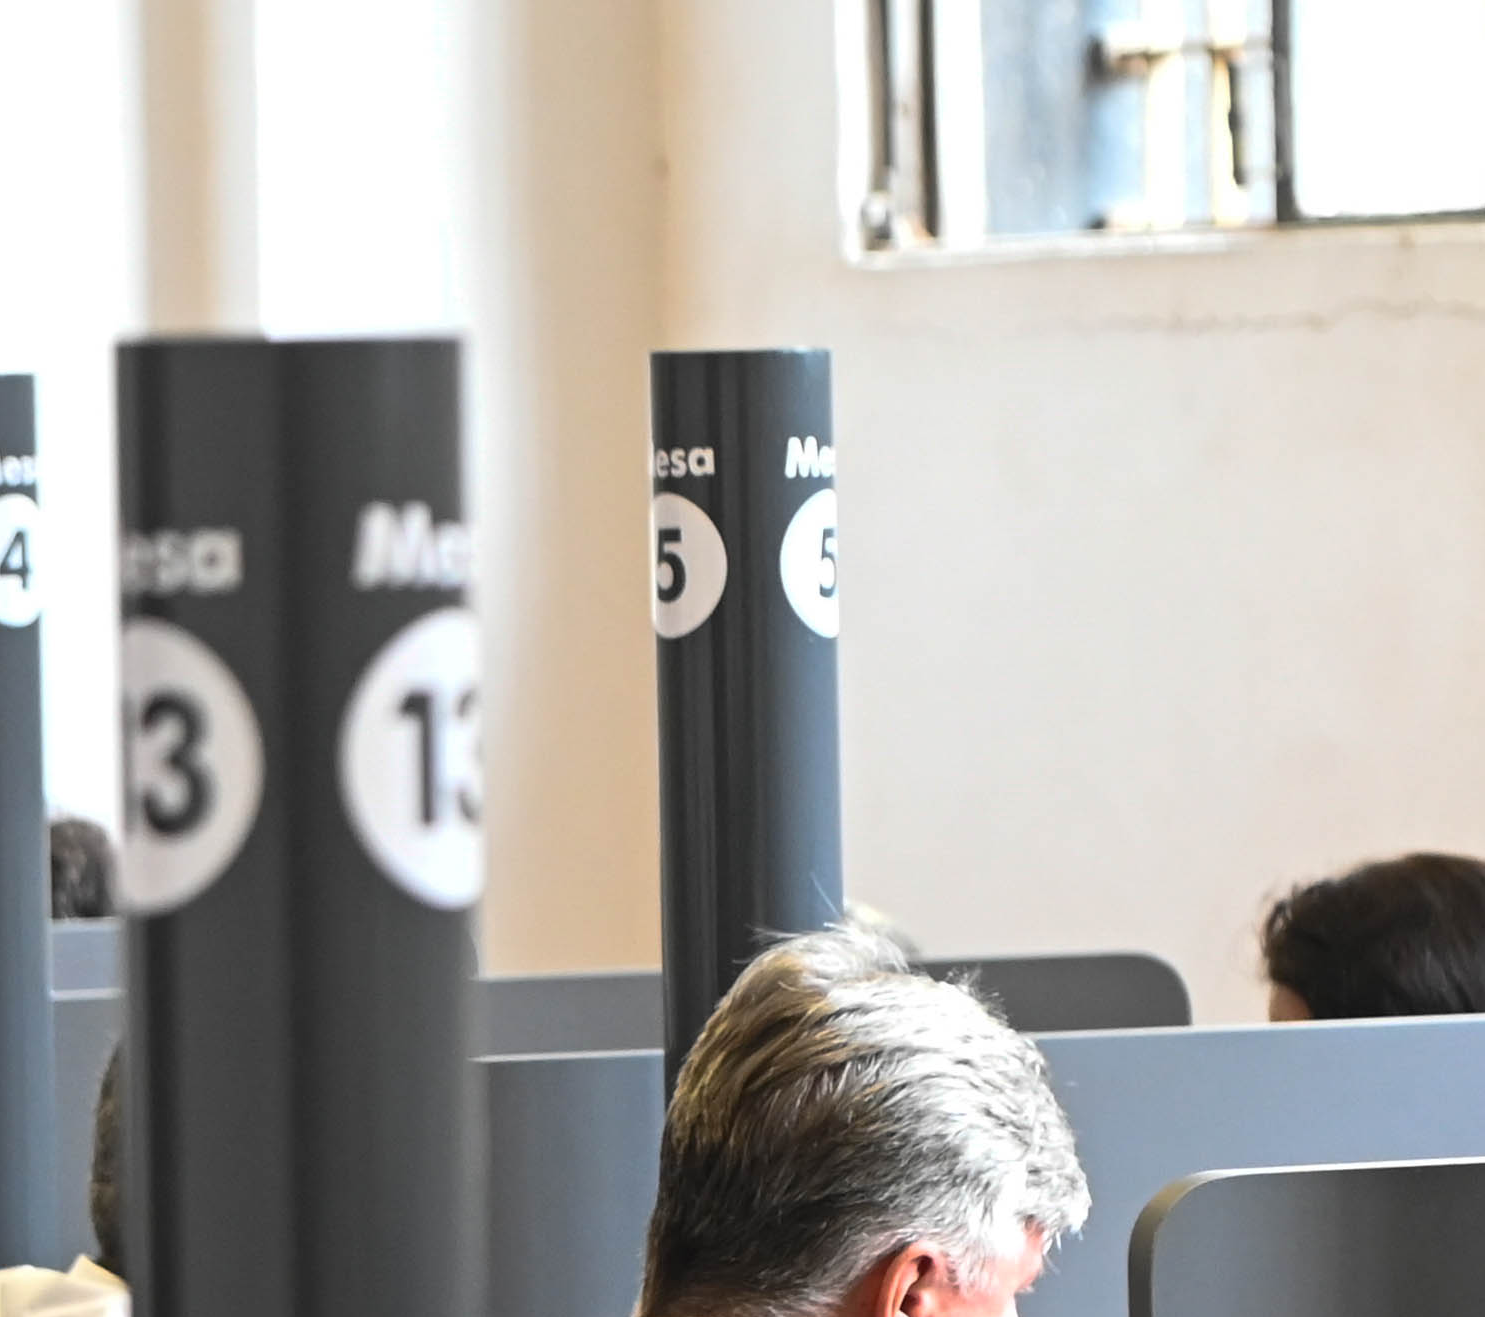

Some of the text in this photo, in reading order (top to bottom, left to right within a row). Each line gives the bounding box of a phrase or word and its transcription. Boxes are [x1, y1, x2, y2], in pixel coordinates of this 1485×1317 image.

[653, 446, 716, 479] esa
[785, 434, 837, 480] Me
[121, 526, 244, 595] esa
[353, 500, 473, 590] Me
[656, 526, 687, 604] 5
[818, 527, 839, 599] 5
[124, 690, 217, 838] 3
